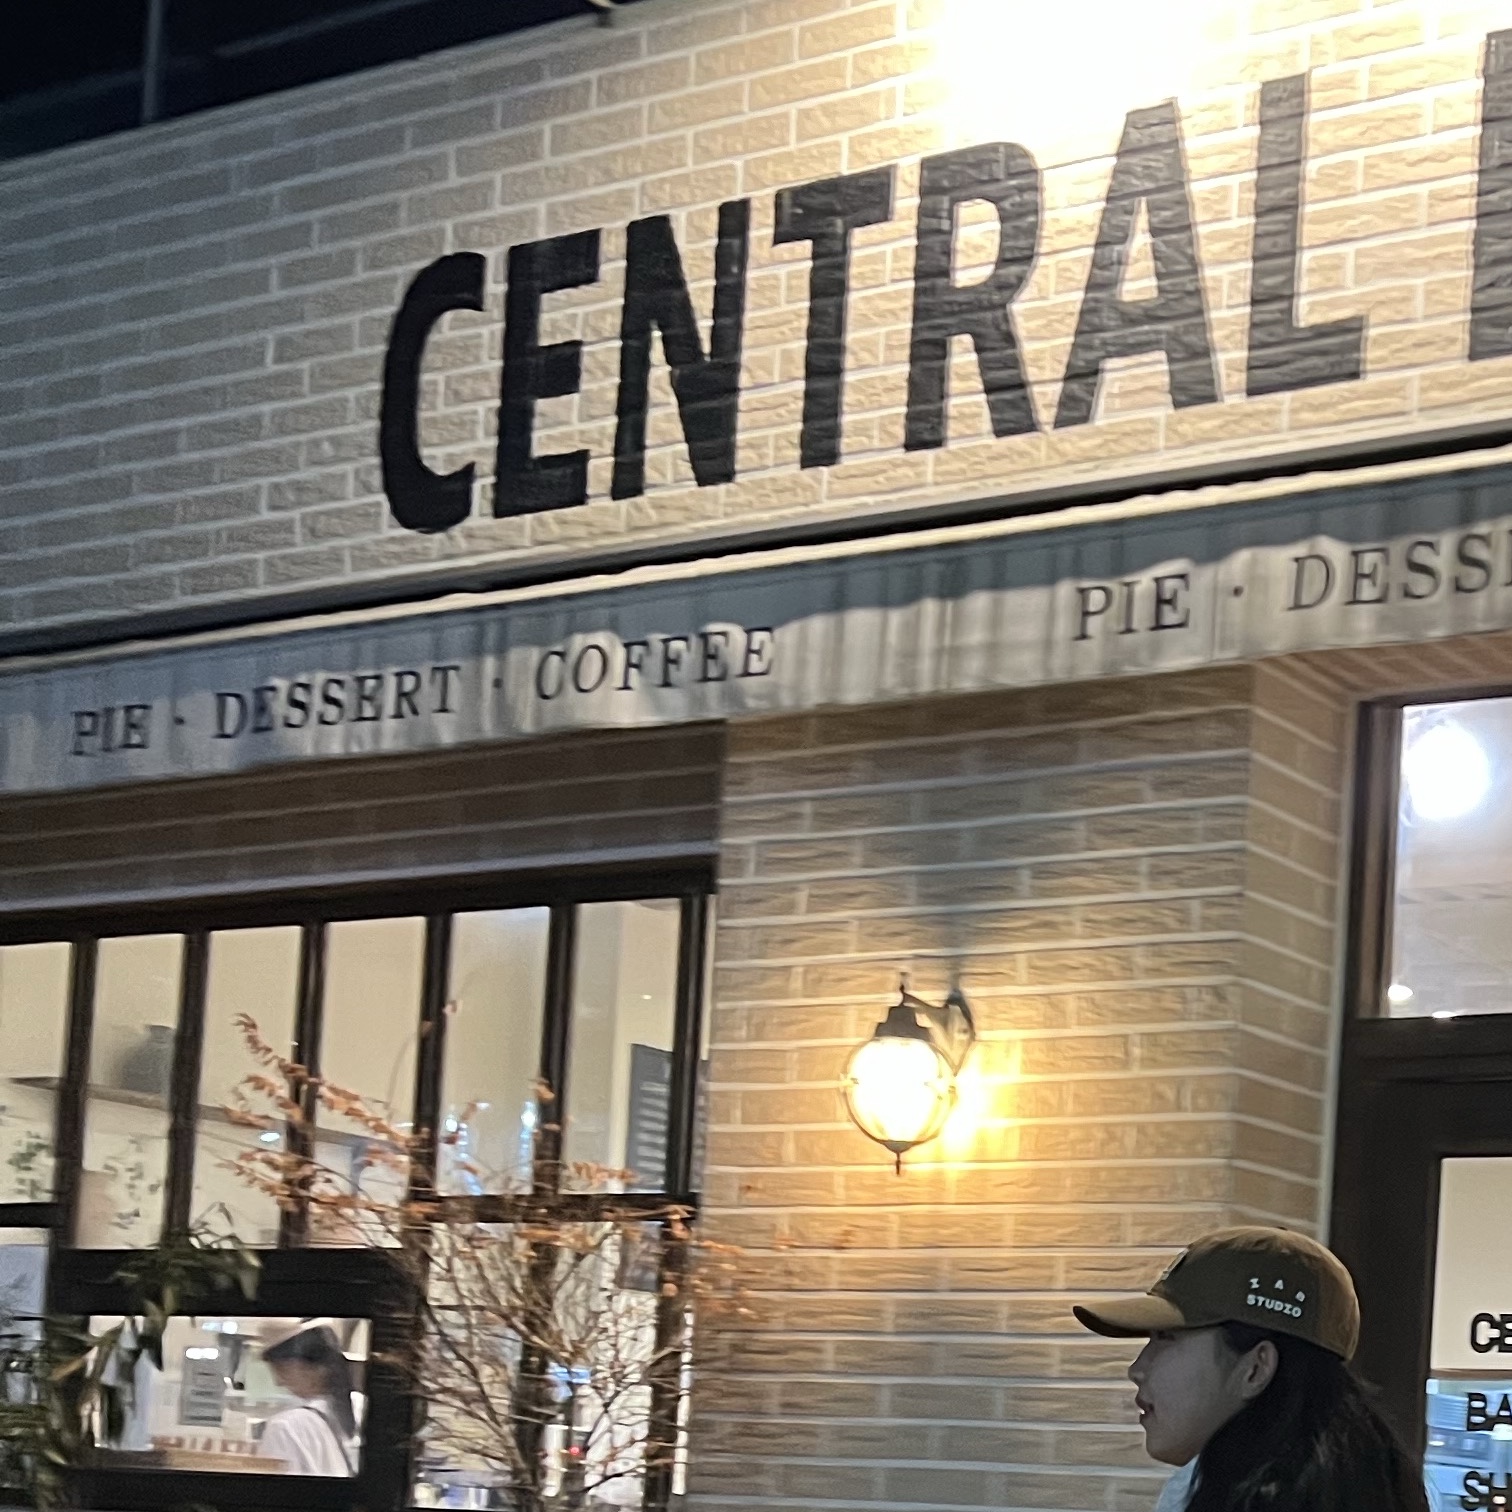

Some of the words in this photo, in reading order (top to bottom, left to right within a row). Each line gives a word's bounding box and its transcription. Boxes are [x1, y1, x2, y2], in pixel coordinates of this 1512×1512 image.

[380, 70, 1366, 534] CENTRAL
[1073, 572, 1191, 641] PIE
[70, 703, 152, 756] PIE
[212, 664, 462, 741] DESSERT
[535, 626, 777, 703] COFFEE
[1246, 1293, 1302, 1318] STUDIO
